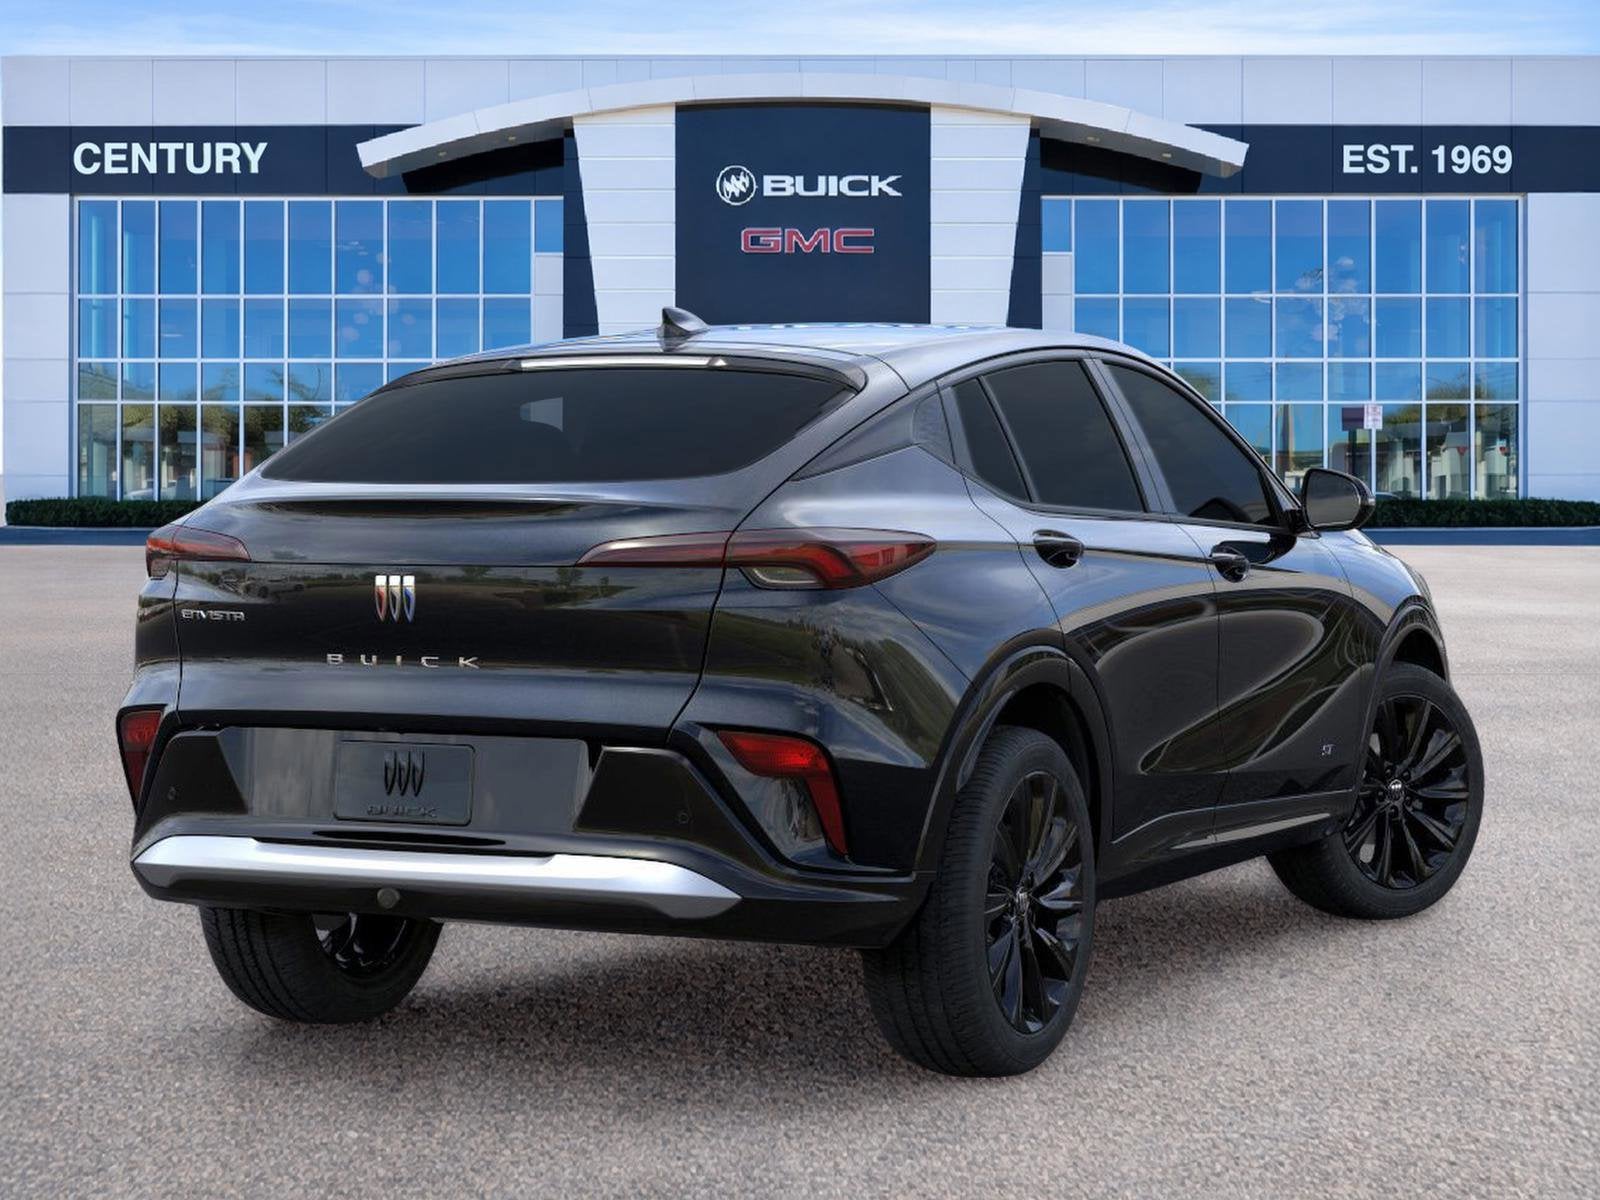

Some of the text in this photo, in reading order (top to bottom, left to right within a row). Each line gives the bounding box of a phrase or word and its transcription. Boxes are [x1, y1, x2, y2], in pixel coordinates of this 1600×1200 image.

[73, 142, 268, 175] CENTURY
[1342, 144, 1513, 174] EST. 1969
[762, 174, 903, 197] BUICK
[741, 227, 875, 253] GMC
[326, 653, 480, 670] BUICK
